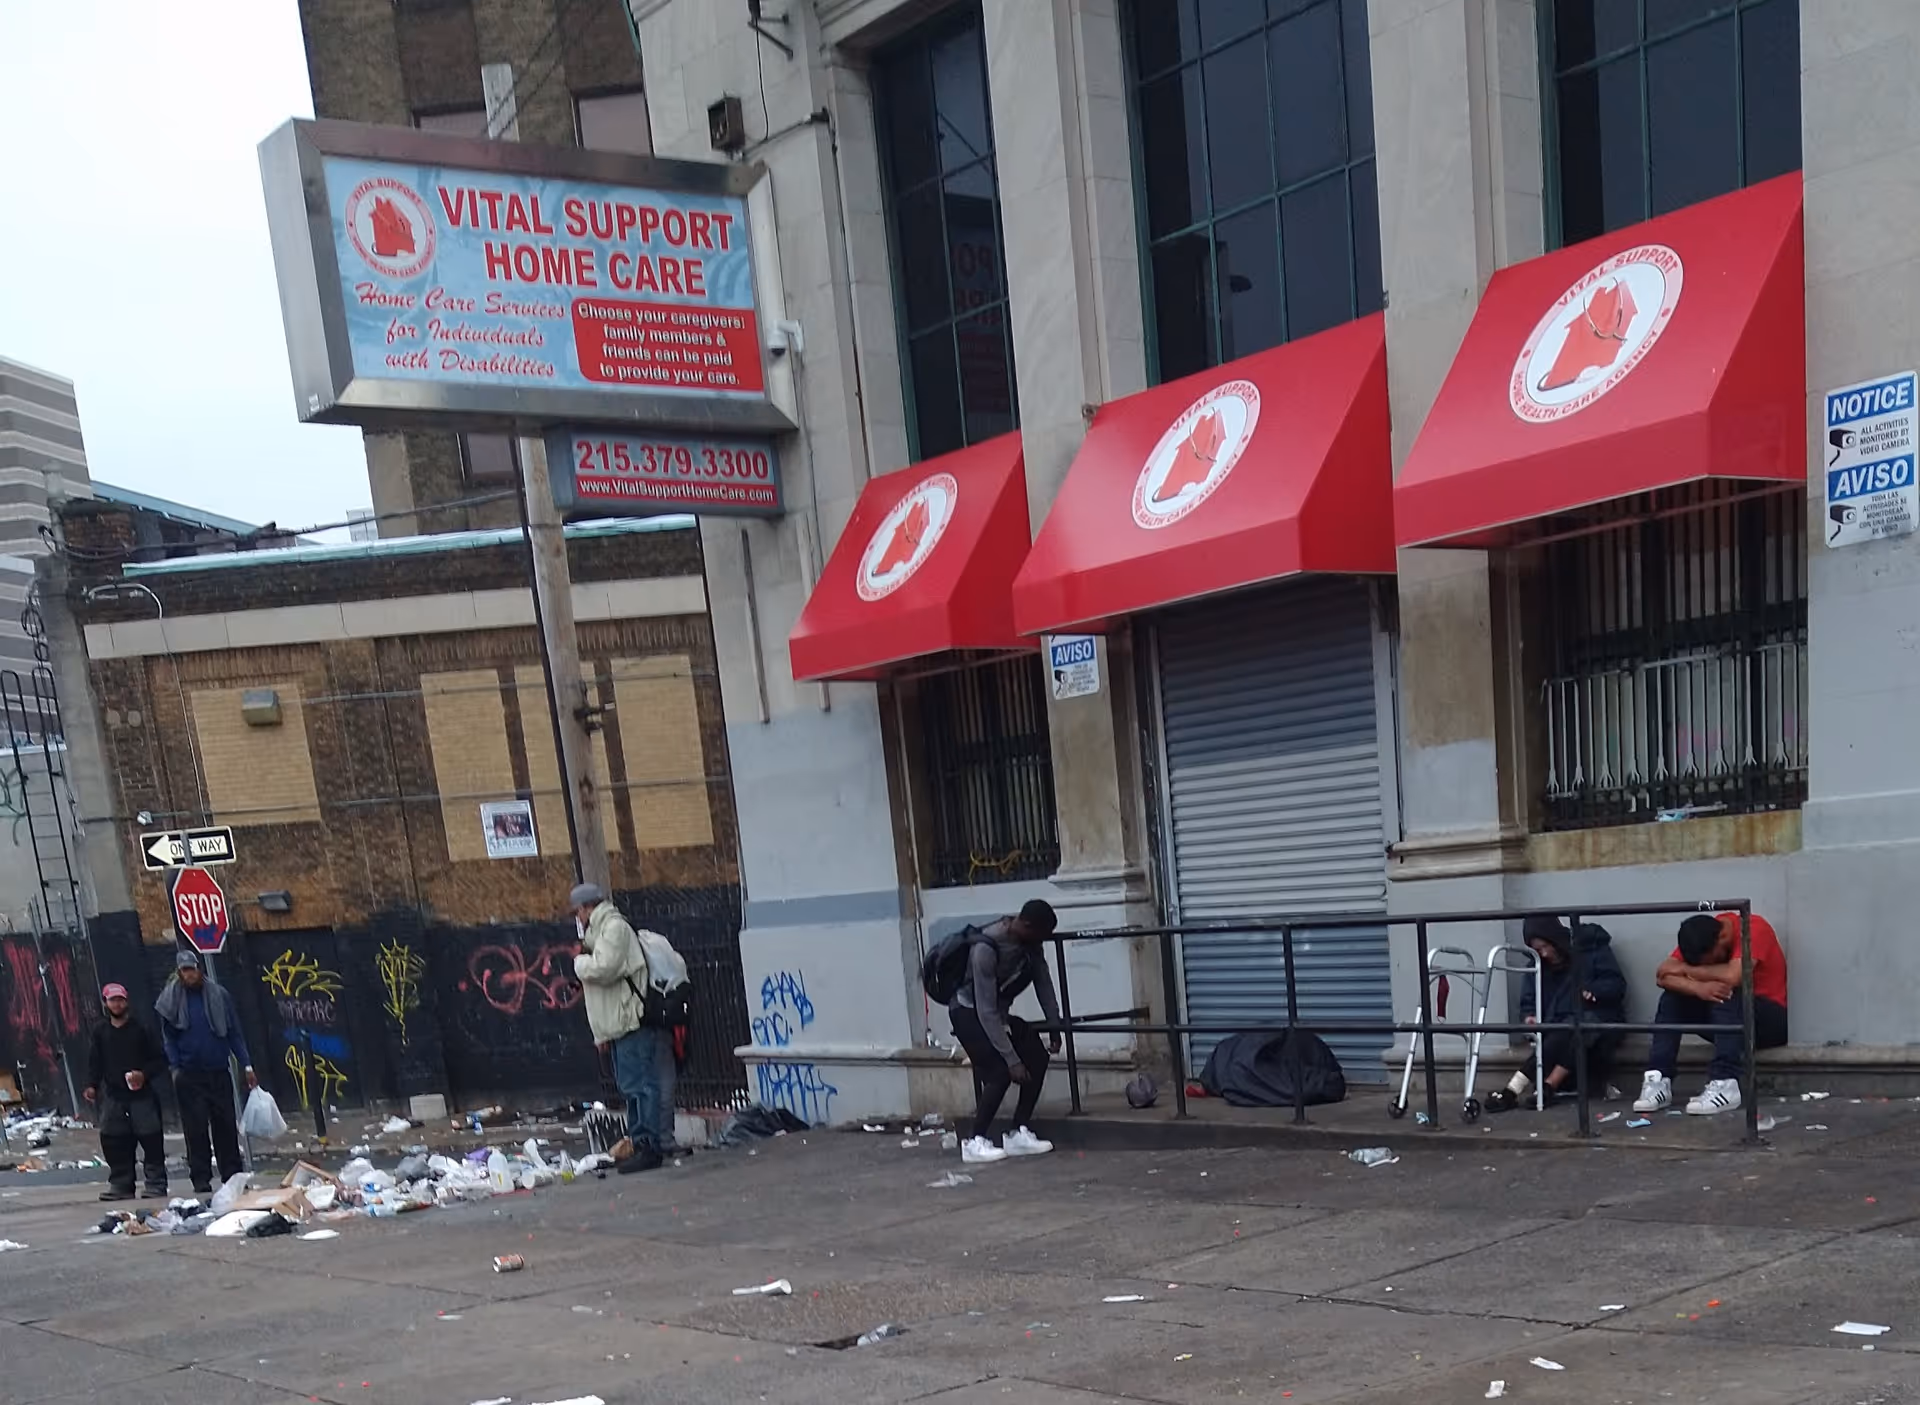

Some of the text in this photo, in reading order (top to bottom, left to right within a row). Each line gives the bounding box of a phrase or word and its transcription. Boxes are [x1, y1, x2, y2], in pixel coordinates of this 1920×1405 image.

[437, 185, 733, 252] VITAL SUPPORT
[484, 241, 598, 290] HOME
[608, 250, 707, 297] CARE
[1558, 248, 1679, 307] VITAL SUPPORT
[355, 282, 566, 318] Home Care Services
[578, 302, 632, 322] Choose
[636, 308, 668, 325] your
[386, 316, 545, 348] for Individuals
[603, 323, 727, 347] family members &
[385, 348, 555, 377] with Disabilities
[602, 342, 733, 368] friends can be paid
[600, 362, 740, 385] to provide your care.
[1520, 401, 1558, 420] HEALTH
[1561, 390, 1601, 415] CARE
[1605, 329, 1658, 389] AGENCY
[1213, 382, 1258, 406] SUPPORT
[1831, 381, 1911, 422] NOTICE
[1860, 427, 1910, 445] MONITORED BY
[1861, 416, 1909, 435] ALL ACTIVITIES
[576, 439, 769, 480] 215.379.3300
[1859, 437, 1910, 456] VIDEO CAMERA
[579, 478, 774, 502] www.VitalSupportHomeCare.com
[1834, 458, 1910, 498] AVISO
[1055, 640, 1092, 666] AVISO
[197, 838, 222, 853] WAY
[178, 892, 222, 926] STOP
